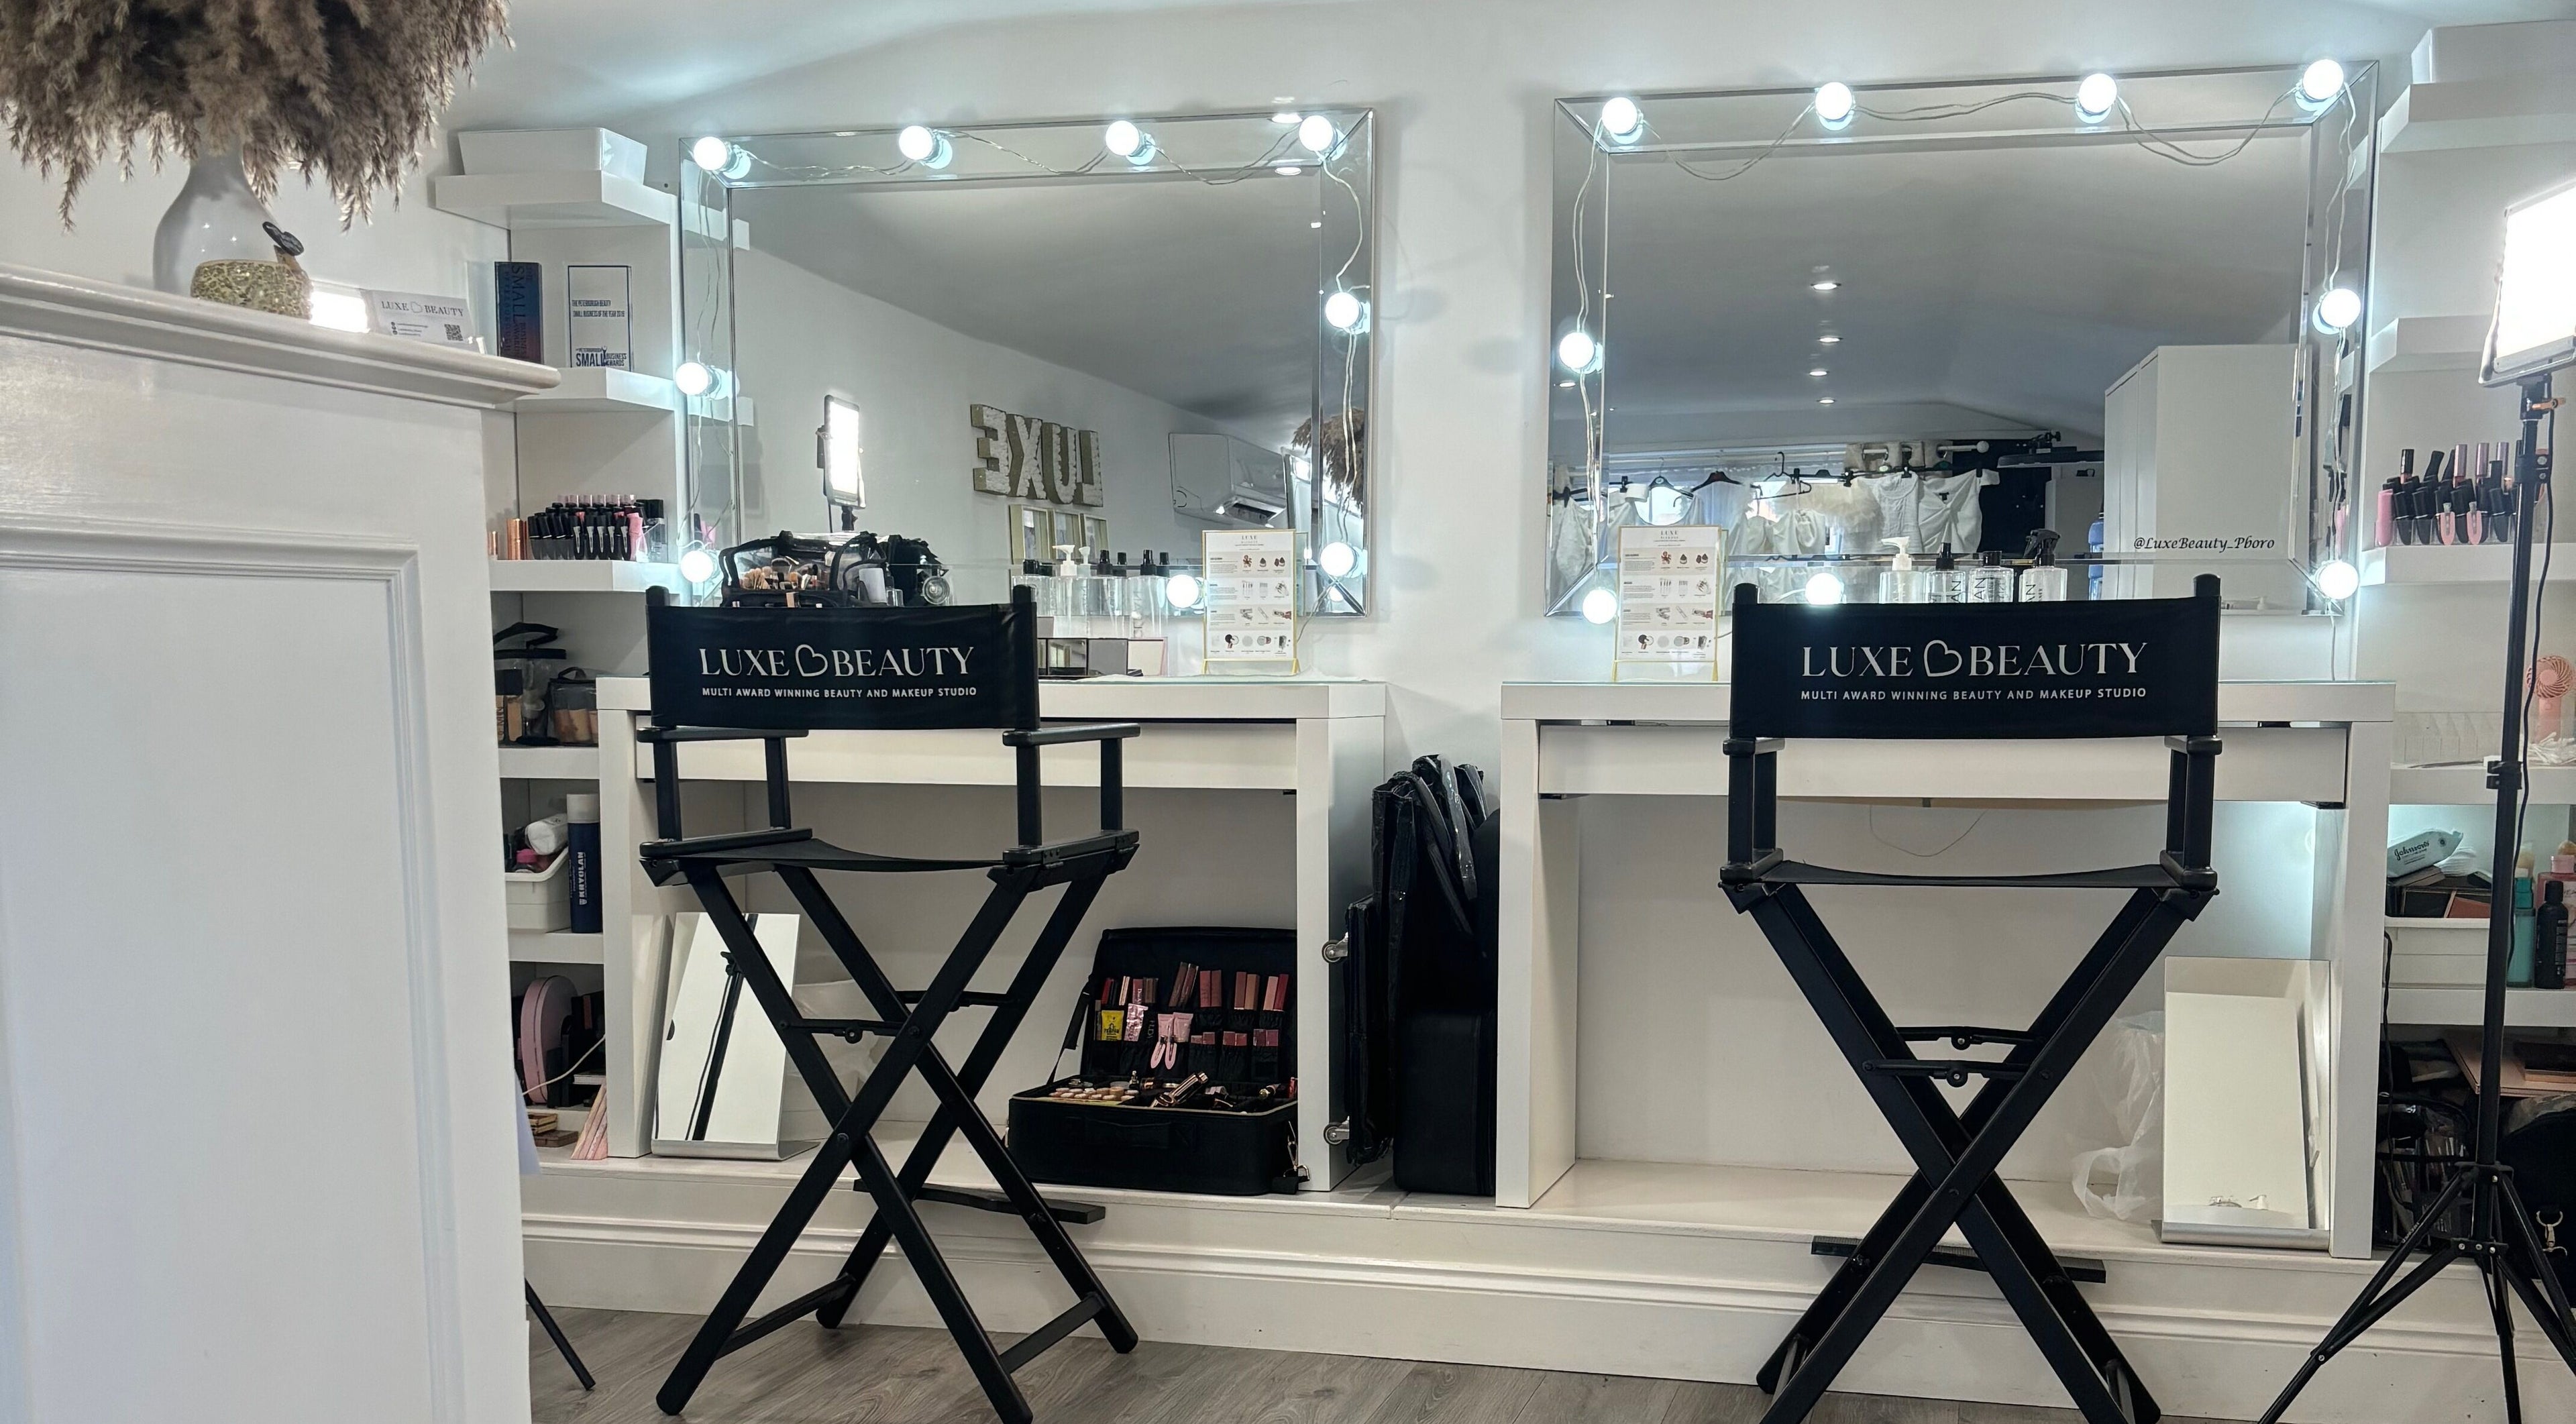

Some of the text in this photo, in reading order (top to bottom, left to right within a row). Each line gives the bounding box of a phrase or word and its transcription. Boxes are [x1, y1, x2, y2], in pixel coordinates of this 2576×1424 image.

[511, 265, 526, 323] SMALL
[381, 300, 409, 311] LUXE
[424, 305, 464, 317] BEAUTY
[576, 353, 605, 366] SMALL
[2133, 535, 2275, 553] @LuxeBeauty_Pboro
[700, 646, 975, 677] LUXE BEAUTY
[1803, 643, 2148, 677] LUXE BEAUTY
[702, 687, 977, 698] MULTI AWARD WINNING BEAUTY AND MAKEUP STUDIO
[1801, 688, 2146, 700] MULTI AWARD WINNING BEAUTY AND MAKEUP STUDIO
